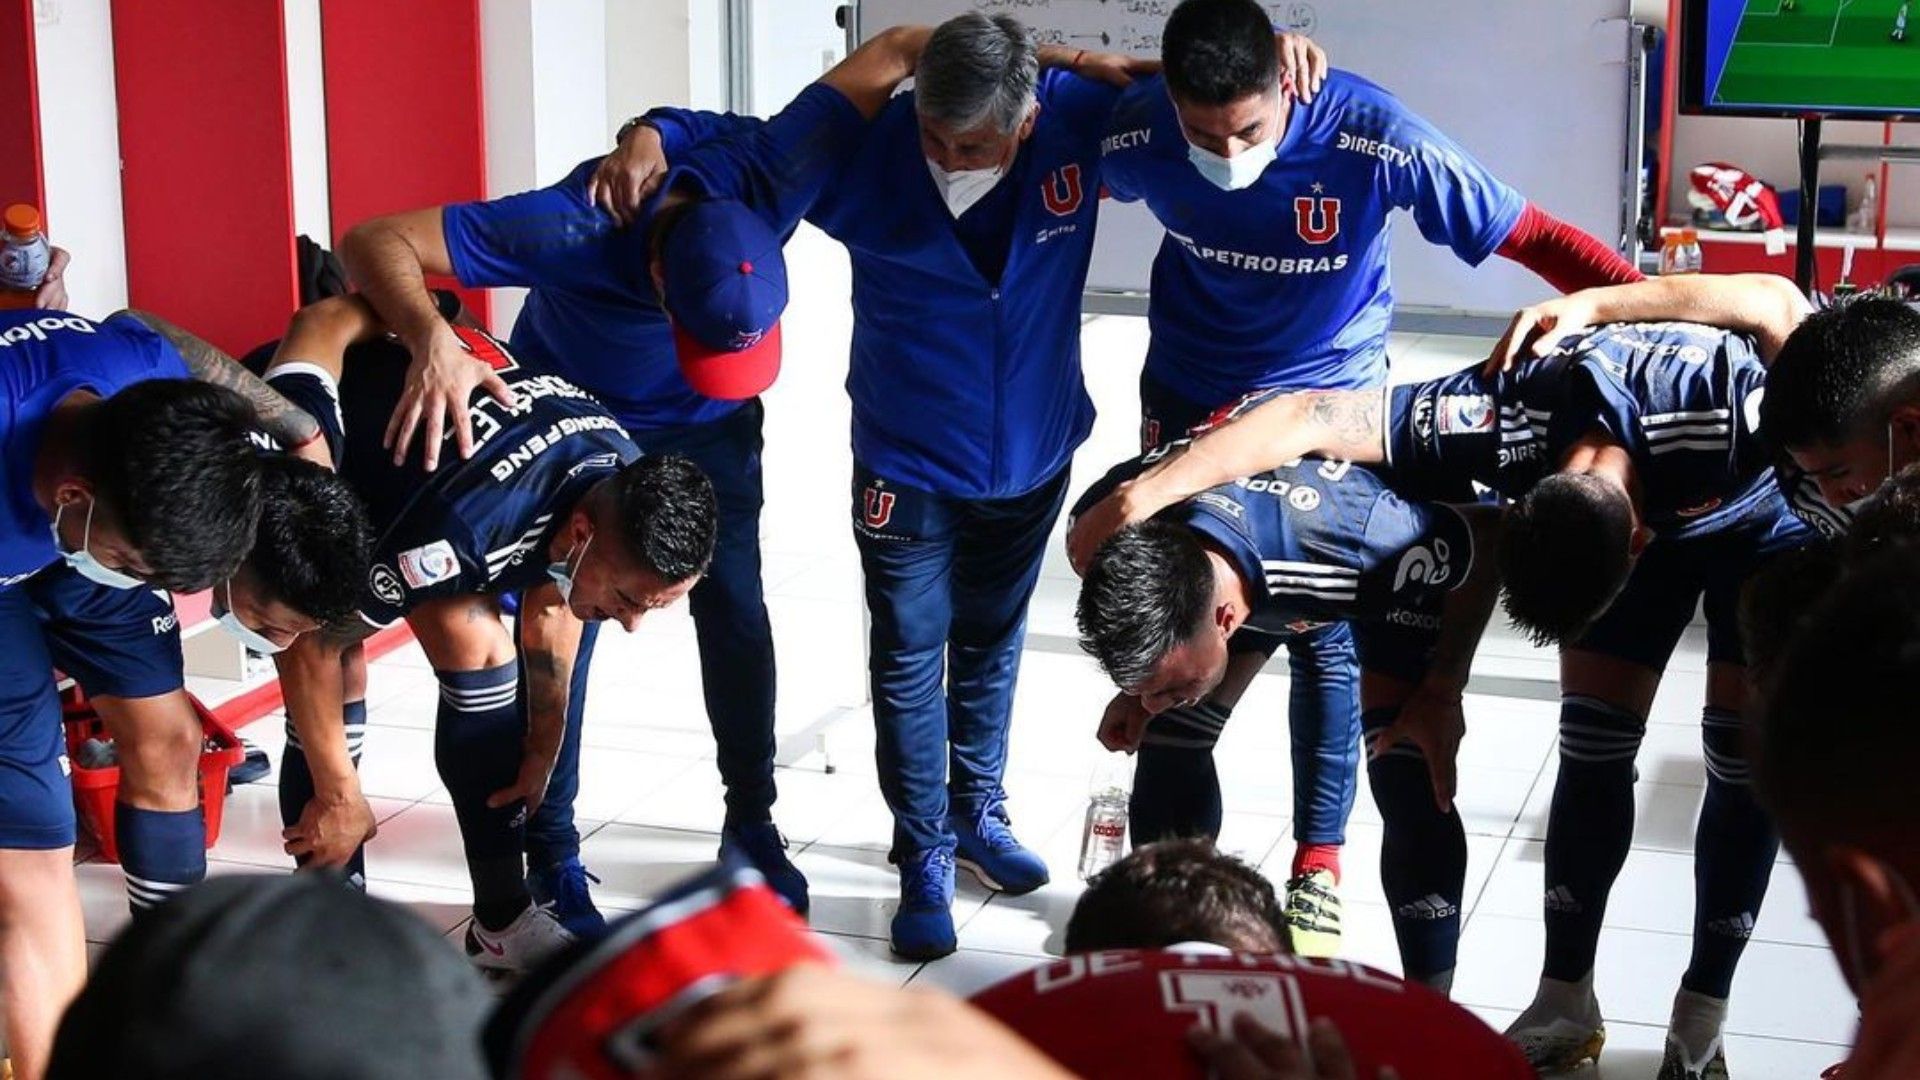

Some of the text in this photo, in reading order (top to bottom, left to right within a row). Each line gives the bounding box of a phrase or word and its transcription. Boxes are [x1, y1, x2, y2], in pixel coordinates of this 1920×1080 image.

[1337, 131, 1412, 168] DIRECTV
[1041, 163, 1084, 216] U
[1294, 196, 1341, 245] U
[1201, 246, 1349, 275] PETROBRAS
[865, 487, 896, 529] U
[1034, 950, 1143, 995] DE
